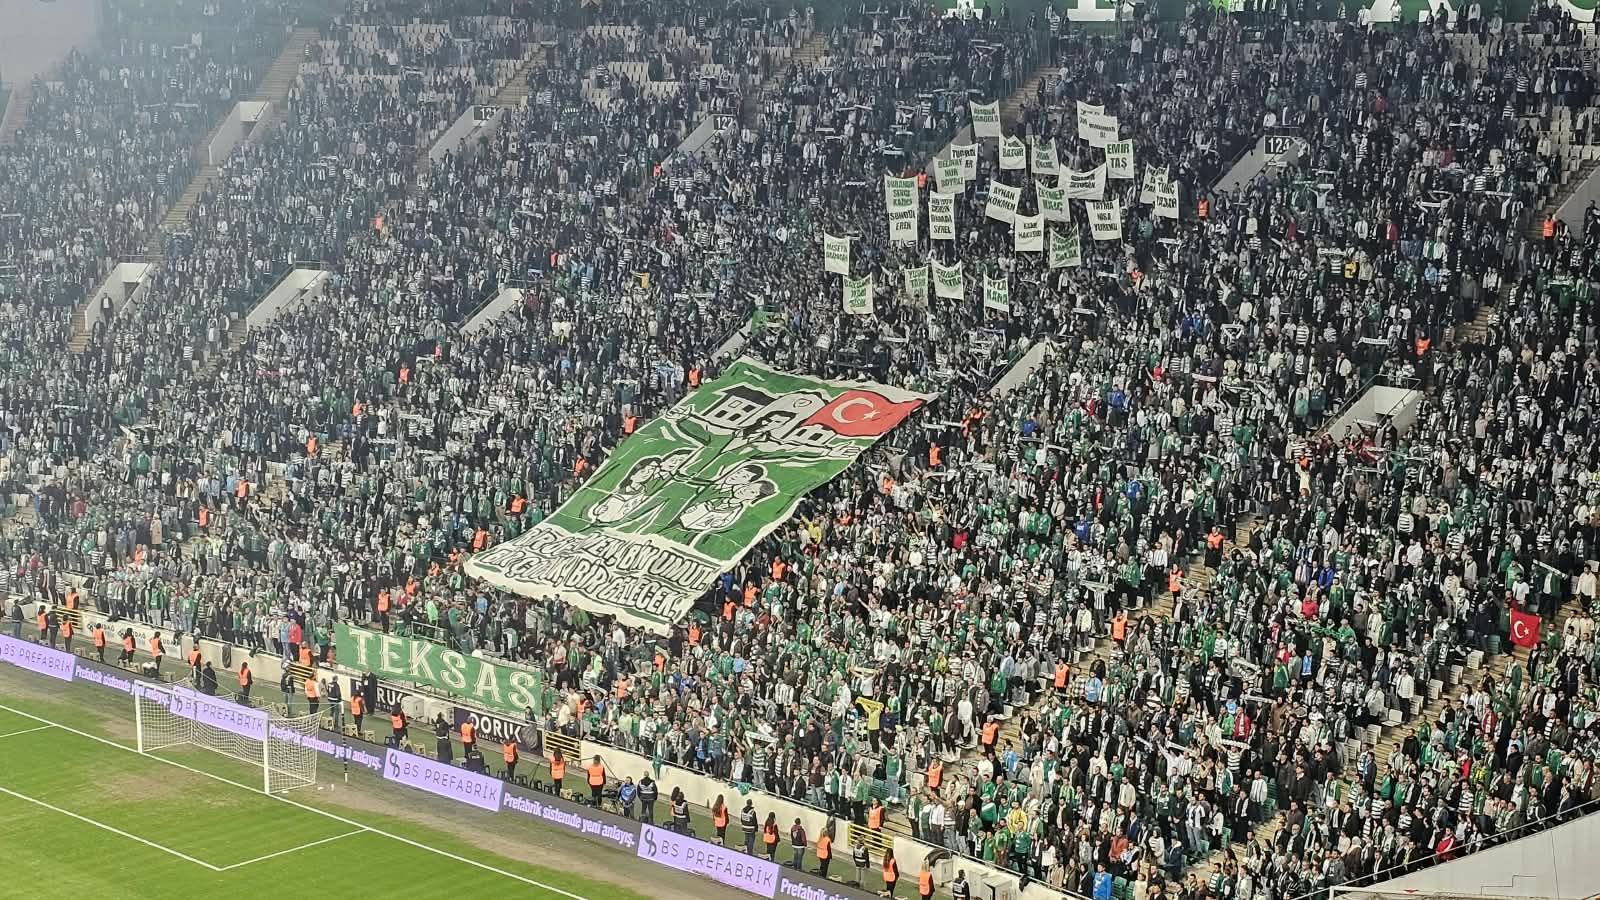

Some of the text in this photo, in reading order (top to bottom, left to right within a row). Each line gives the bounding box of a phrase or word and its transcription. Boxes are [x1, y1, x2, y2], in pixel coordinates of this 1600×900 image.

[1110, 157, 1128, 171] TAŞ
[992, 185, 1016, 200] AYHAN
[565, 558, 610, 593] BİR
[4, 644, 16, 656] BS
[349, 628, 536, 710] TEKSAS
[403, 762, 498, 801] BS PREFABRİK
[503, 792, 636, 848] Prefabrik sistemde yeni anlayış.
[661, 840, 773, 886] BS PREFABRİK
